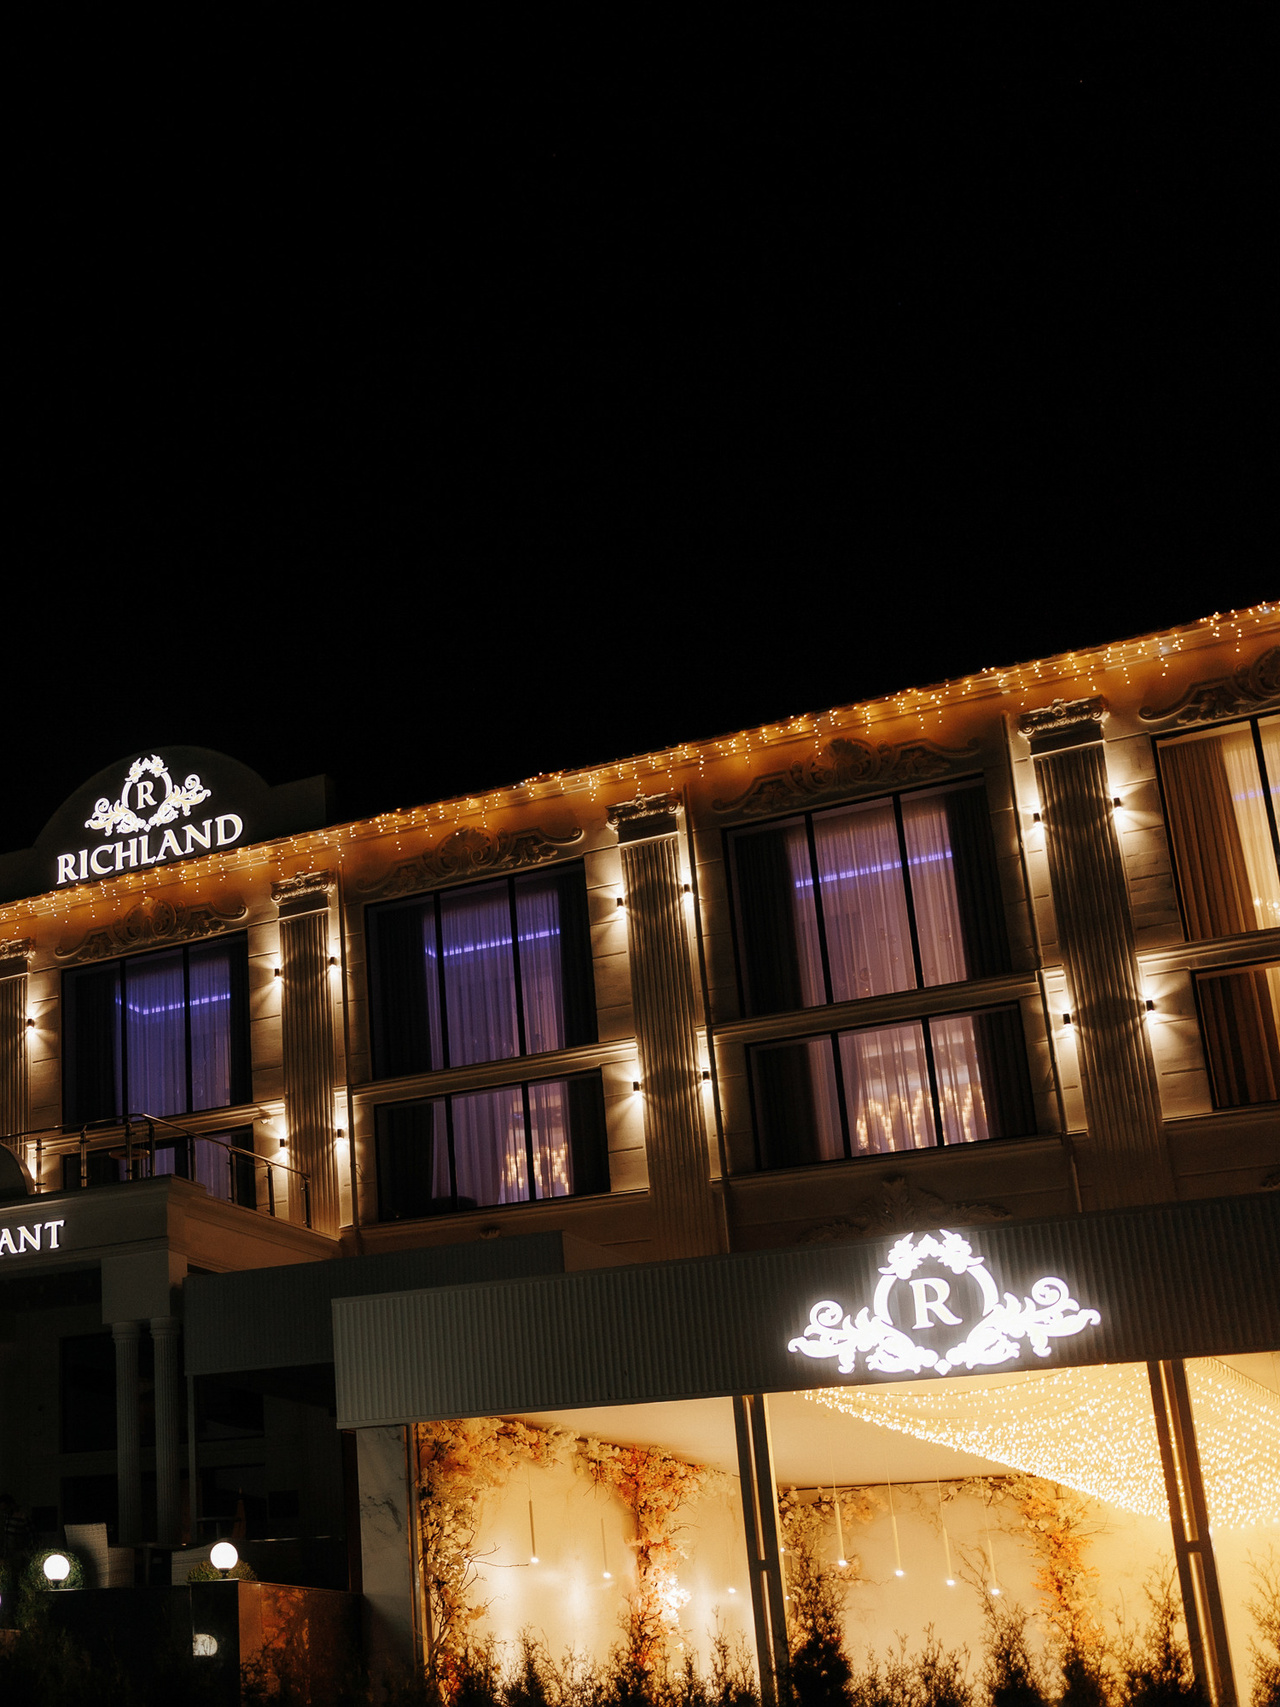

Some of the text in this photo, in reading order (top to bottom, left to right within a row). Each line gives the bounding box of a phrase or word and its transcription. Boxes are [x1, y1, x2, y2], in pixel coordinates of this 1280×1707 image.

[136, 780, 157, 810] R
[56, 813, 244, 886] RICHLAND
[908, 1277, 963, 1330] R
